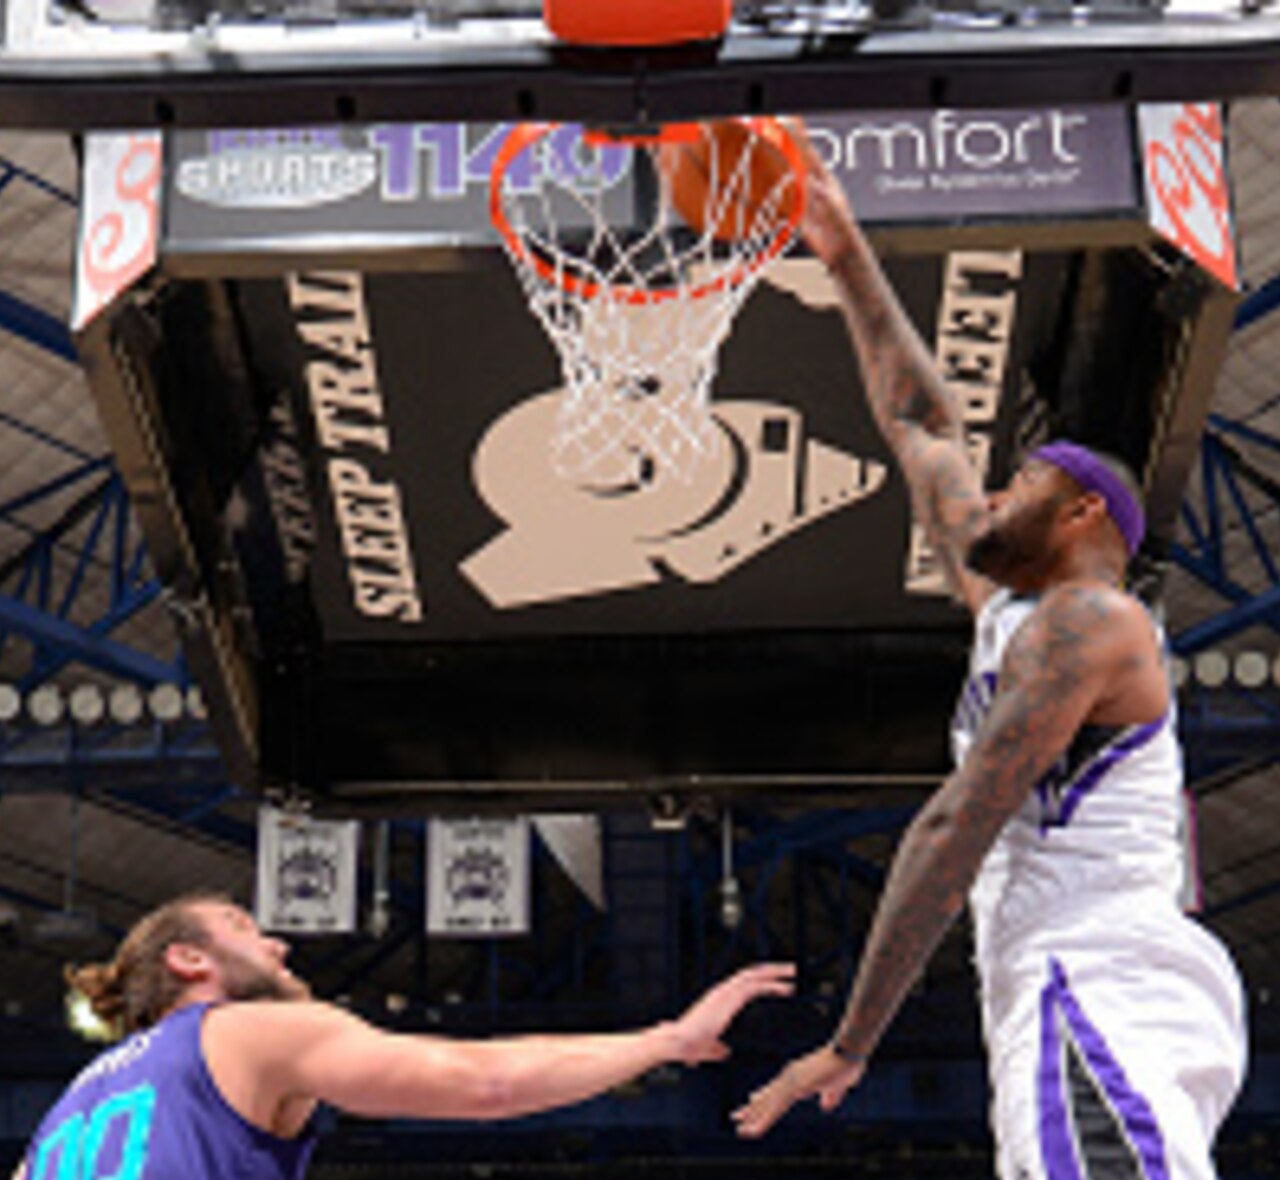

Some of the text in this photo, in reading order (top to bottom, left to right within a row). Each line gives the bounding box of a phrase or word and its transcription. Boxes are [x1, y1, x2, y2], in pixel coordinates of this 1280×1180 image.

[370, 123, 632, 202] 1140
[810, 108, 1087, 171] omfort
[327, 457, 423, 623] SLEEP
